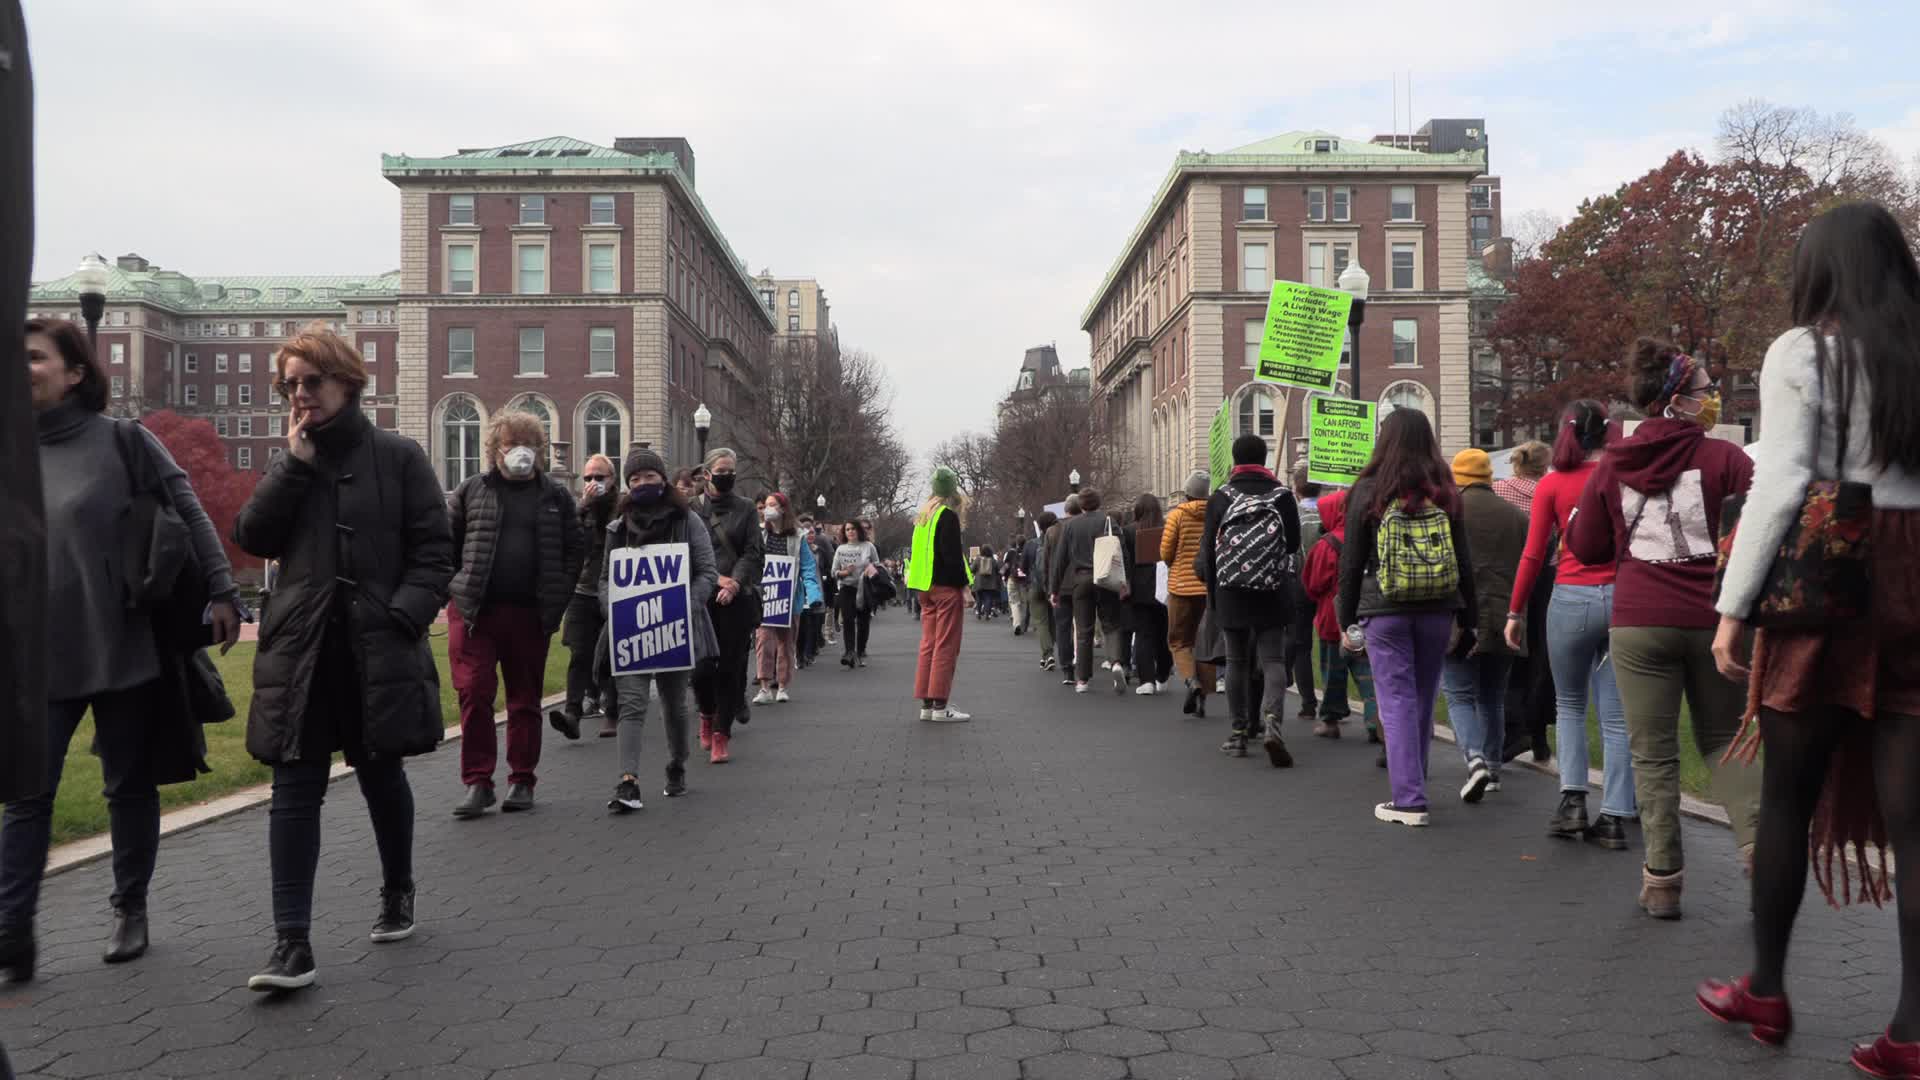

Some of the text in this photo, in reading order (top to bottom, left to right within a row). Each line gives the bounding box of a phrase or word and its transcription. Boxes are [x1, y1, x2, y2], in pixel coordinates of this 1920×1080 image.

[1309, 290, 1339, 300] Contract
[1291, 303, 1316, 313] Living
[1319, 307, 1342, 317] Wage
[1283, 311, 1307, 319] Dental
[1315, 316, 1337, 324] Vision
[1276, 331, 1313, 341] Protections
[1309, 330, 1334, 338] Workers
[1285, 353, 1312, 362] bullying
[1264, 362, 1330, 377] WORKERS ASSEMBLY
[1269, 371, 1321, 383] AGAINST RACISM
[1324, 402, 1359, 410] Billionaire
[1324, 418, 1361, 429] CAN AFFORD
[1314, 429, 1369, 441] CONTRACT JUSTICE
[614, 554, 683, 588] UAW
[764, 561, 791, 578] AW
[636, 596, 663, 629] ON
[762, 598, 789, 618] RIKE
[617, 618, 686, 667] STRIKE
